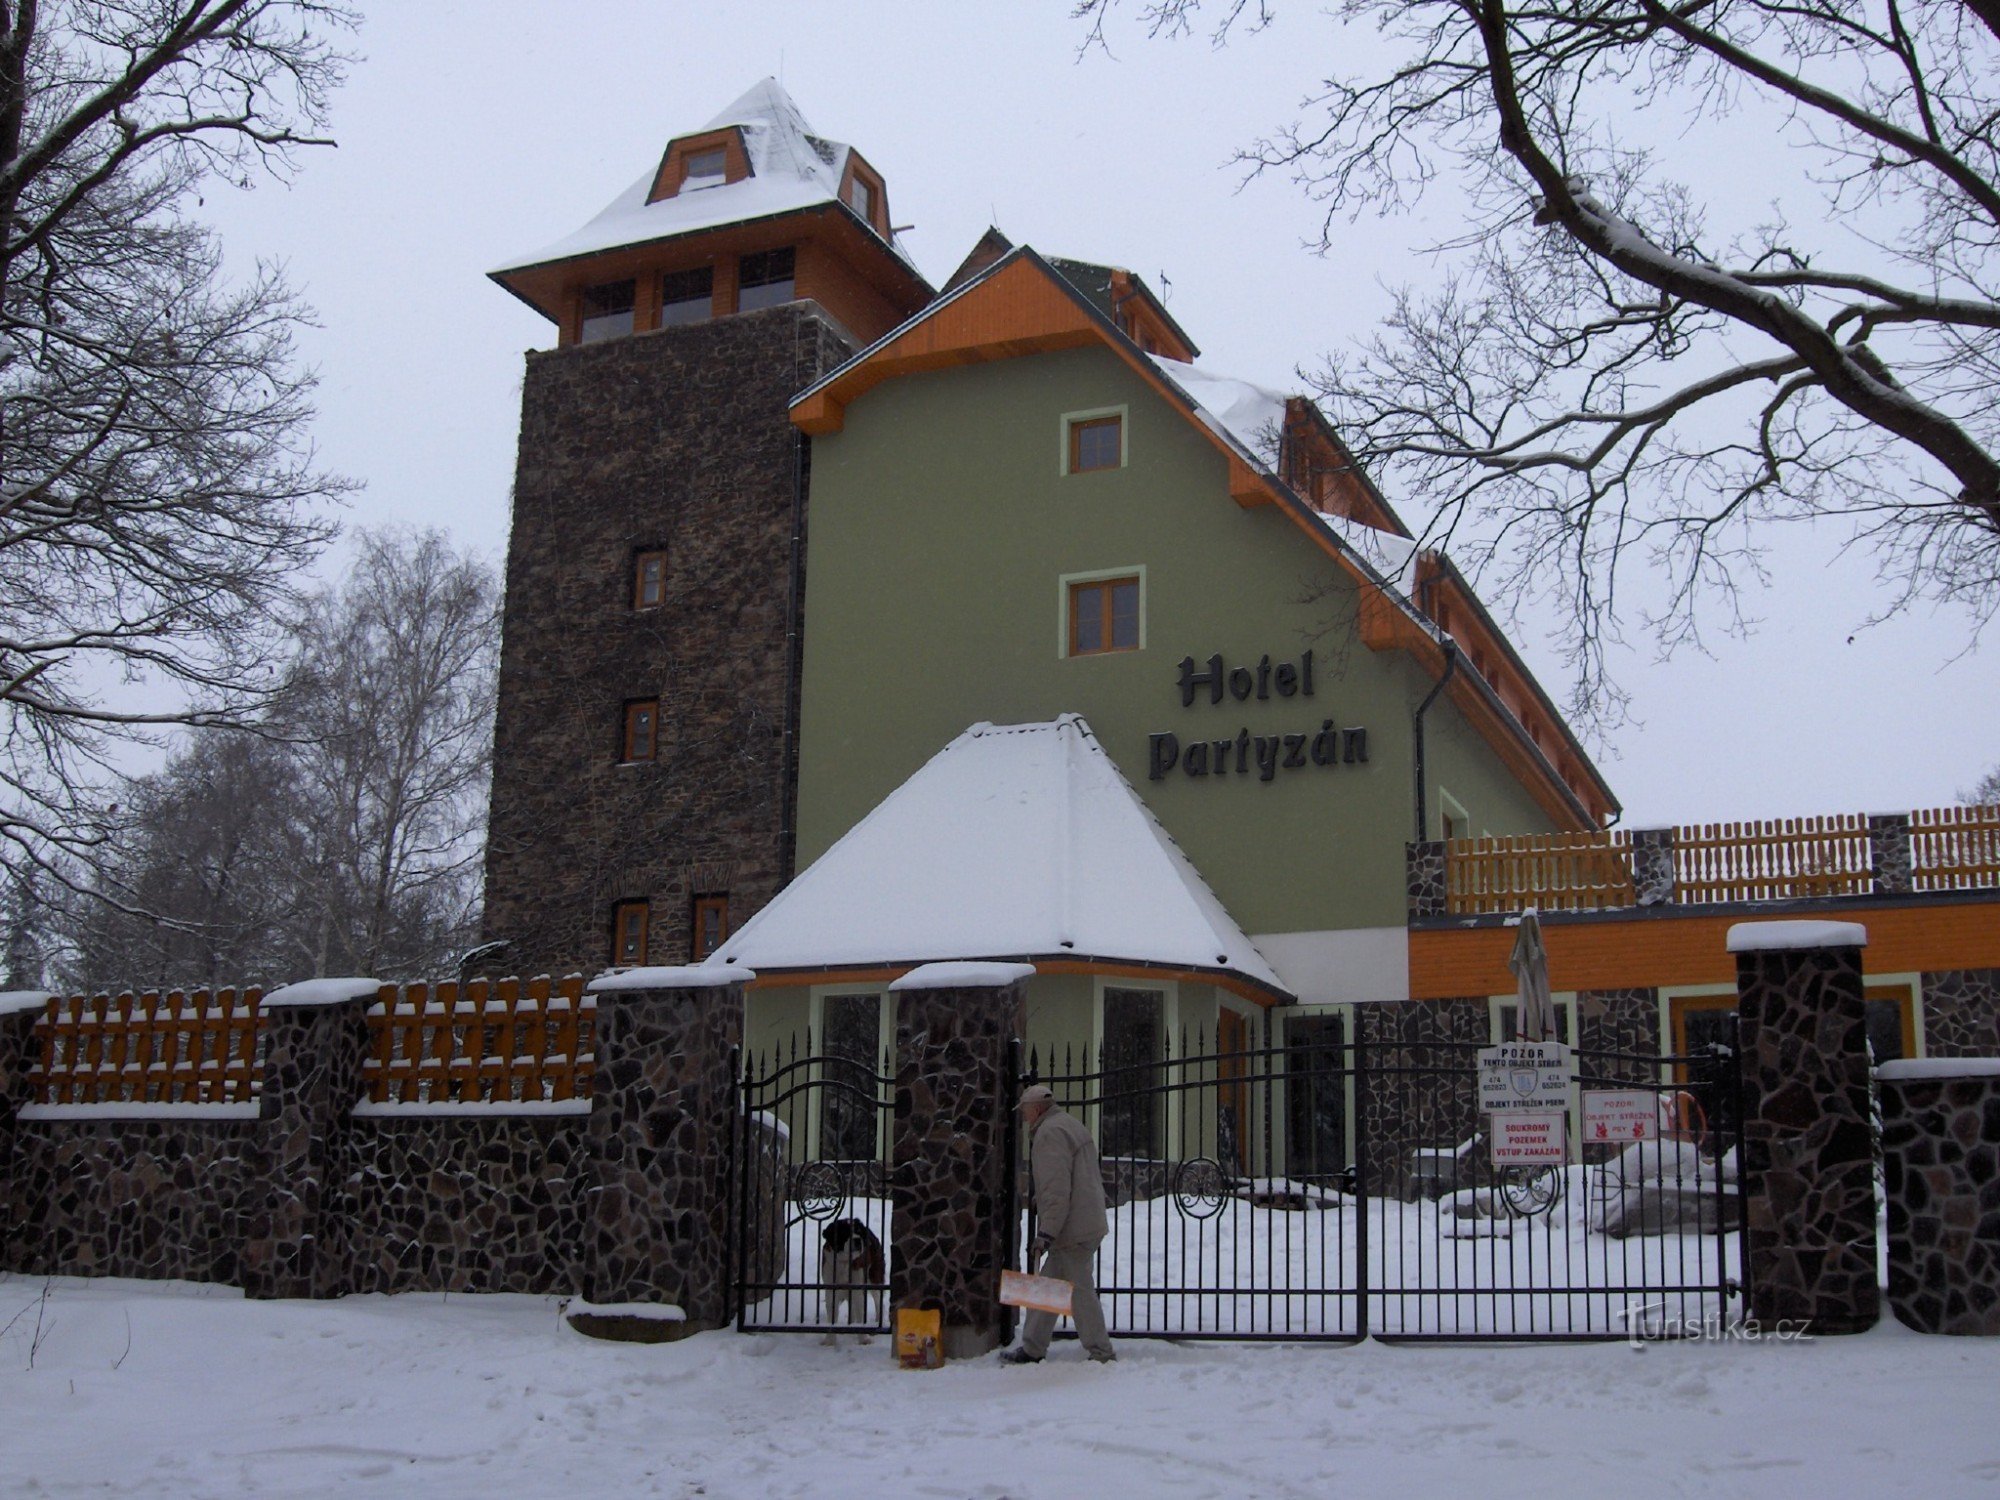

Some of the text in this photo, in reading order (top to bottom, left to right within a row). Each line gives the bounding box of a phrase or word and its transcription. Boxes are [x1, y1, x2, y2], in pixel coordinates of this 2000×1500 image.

[1176, 649, 1315, 708] Hotel
[1149, 719, 1369, 781] Partyzán
[1501, 1048, 1544, 1059] POZOR
[1483, 1059, 1507, 1067] TENTO
[1508, 1059, 1535, 1067] OBJEKT
[1485, 1098, 1565, 1109] OBJEKT STŘEŽEN PSEM
[1586, 1112, 1655, 1121] OBJEKT STŘEŽEN
[1505, 1123, 1550, 1132] SOUKROMÝ
[1509, 1136, 1548, 1144] POZEMEK
[1496, 1146, 1561, 1156] VSTUP ZAKÁZÁN
